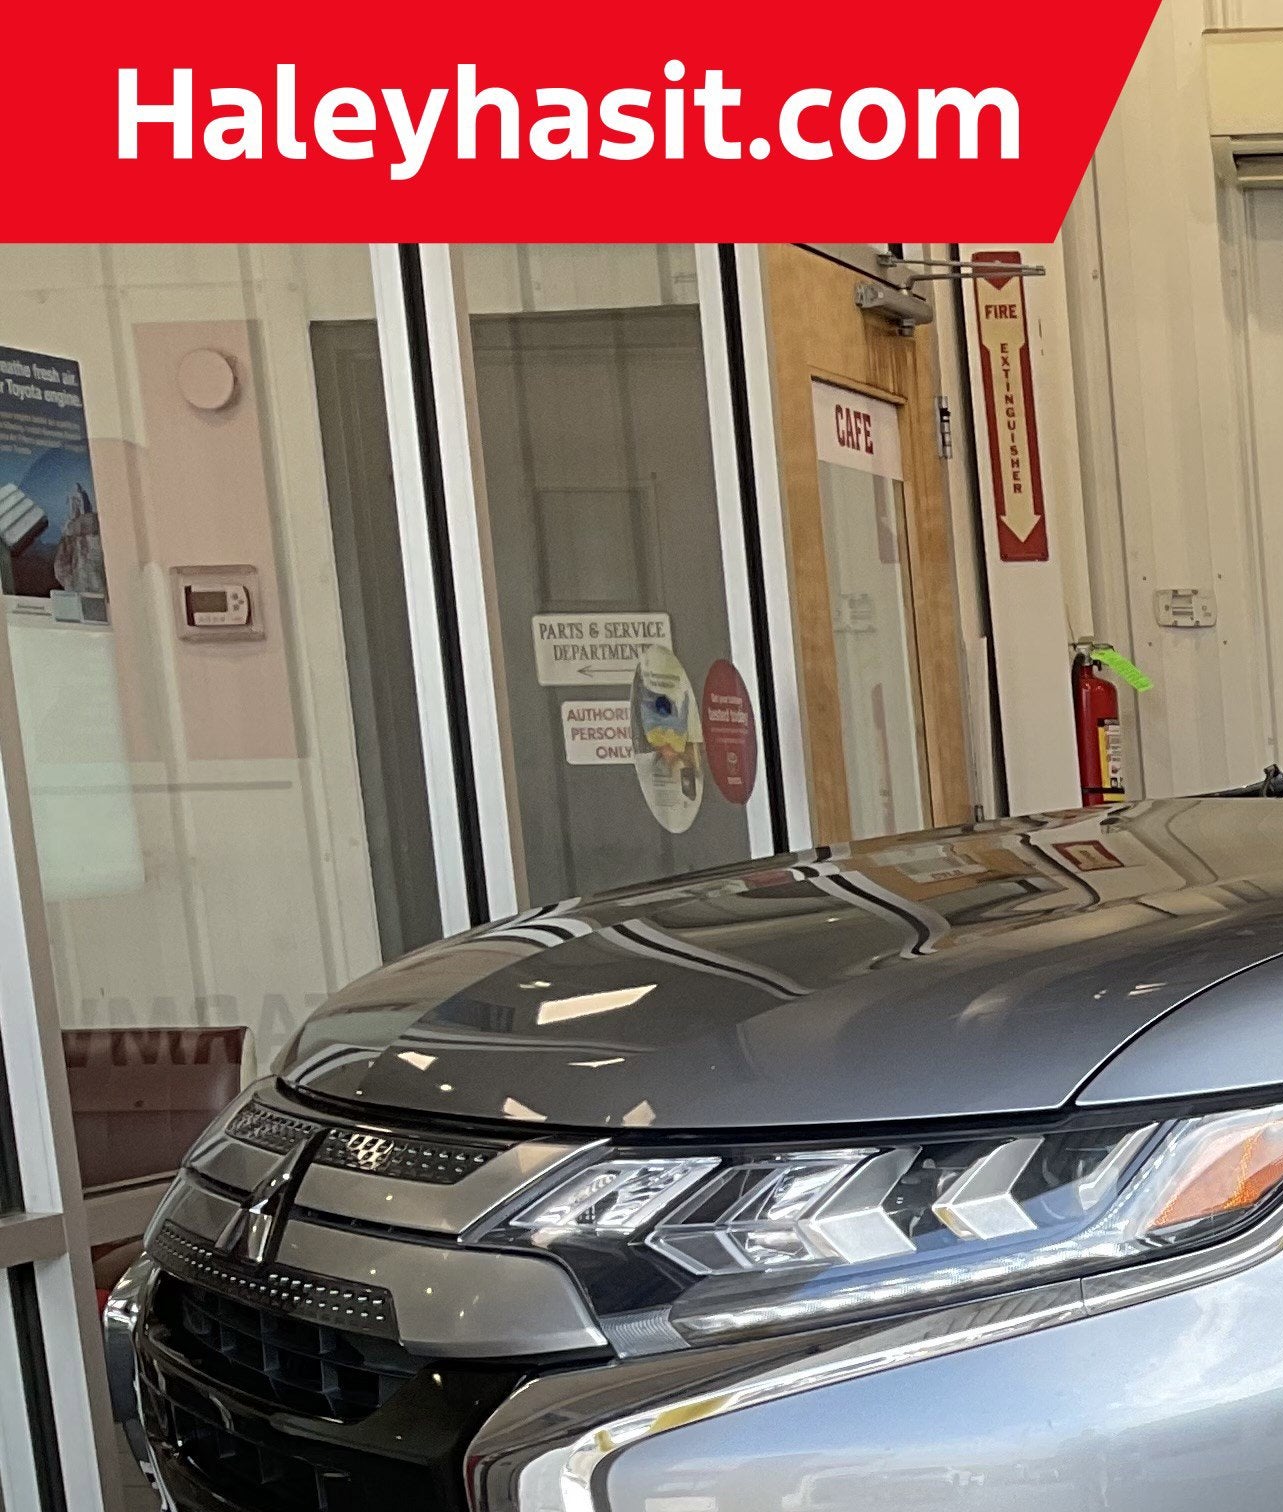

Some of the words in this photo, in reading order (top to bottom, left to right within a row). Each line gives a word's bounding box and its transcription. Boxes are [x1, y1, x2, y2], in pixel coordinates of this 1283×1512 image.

[984, 304, 1017, 319] FIRE
[5, 378, 42, 401] Toyota
[1000, 343, 1022, 494] EXTINGUISHER
[835, 404, 874, 455] CAFE
[538, 622, 583, 640] PARTS
[589, 622, 599, 638] &
[604, 621, 665, 639] SERVICE
[567, 708, 629, 721] AUTHORI
[571, 727, 631, 741] PERSON
[596, 746, 633, 759] ONLY
